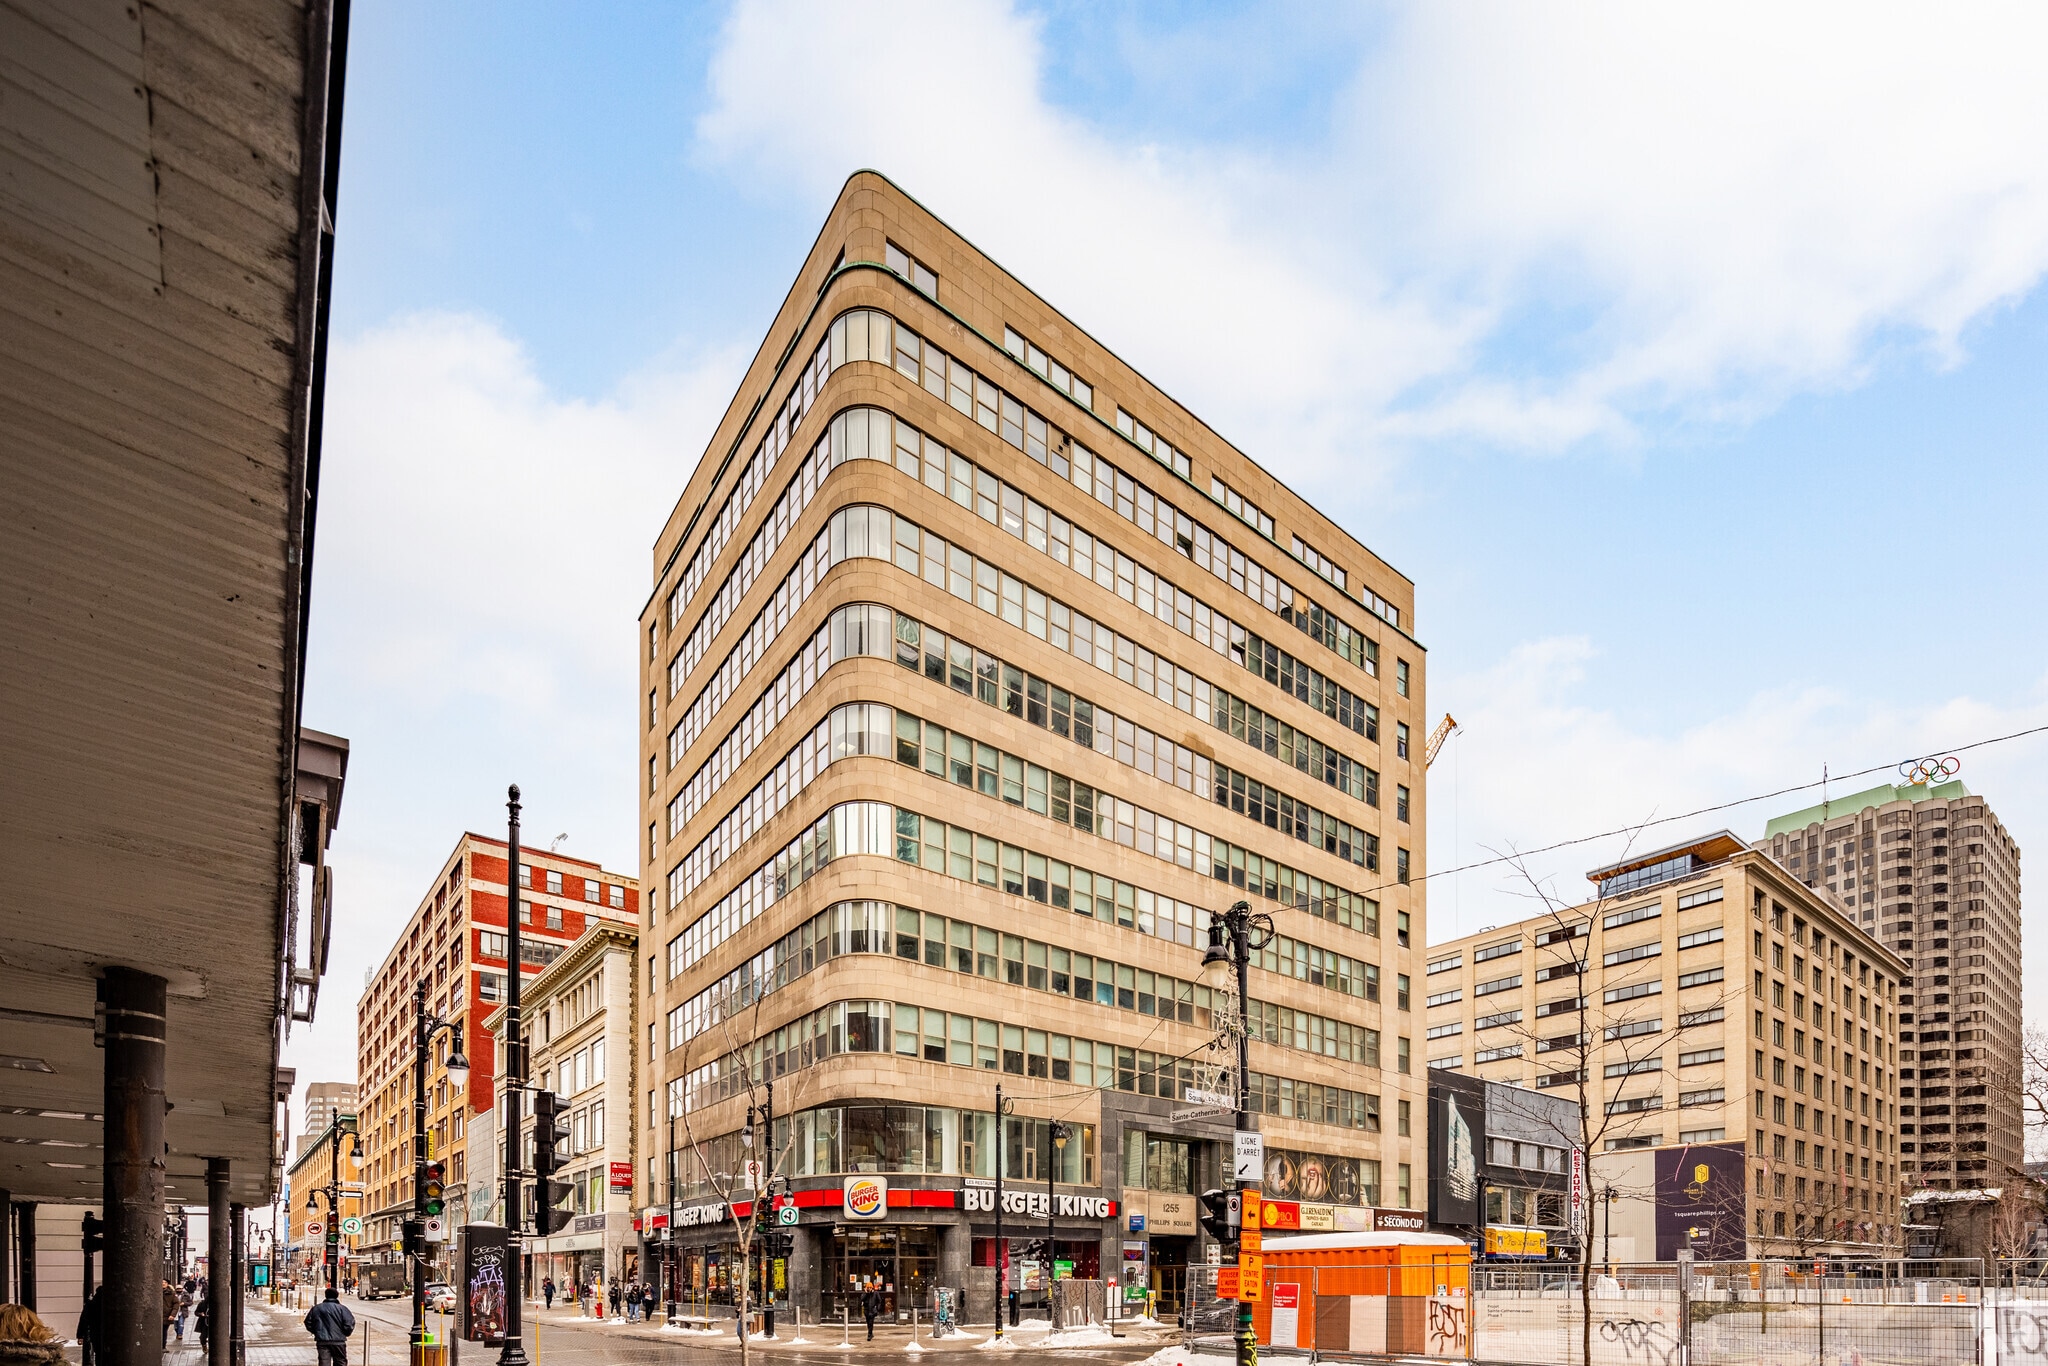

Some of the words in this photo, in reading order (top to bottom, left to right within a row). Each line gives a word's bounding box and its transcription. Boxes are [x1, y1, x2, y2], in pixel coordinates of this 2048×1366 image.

[1241, 1137, 1257, 1146] LIGNE
[850, 1186, 878, 1199] BURGER
[851, 1193, 879, 1208] KING
[1060, 1195, 1109, 1218] KING
[1163, 1203, 1180, 1213] 1255
[670, 1206, 698, 1228] URGER
[700, 1203, 724, 1225] KING
[1384, 1216, 1410, 1228] SECOND
[1410, 1218, 1423, 1229] CUP
[1249, 1257, 1254, 1267] P
[1243, 1270, 1259, 1279] CENTRE
[1244, 1280, 1258, 1288] EATON
